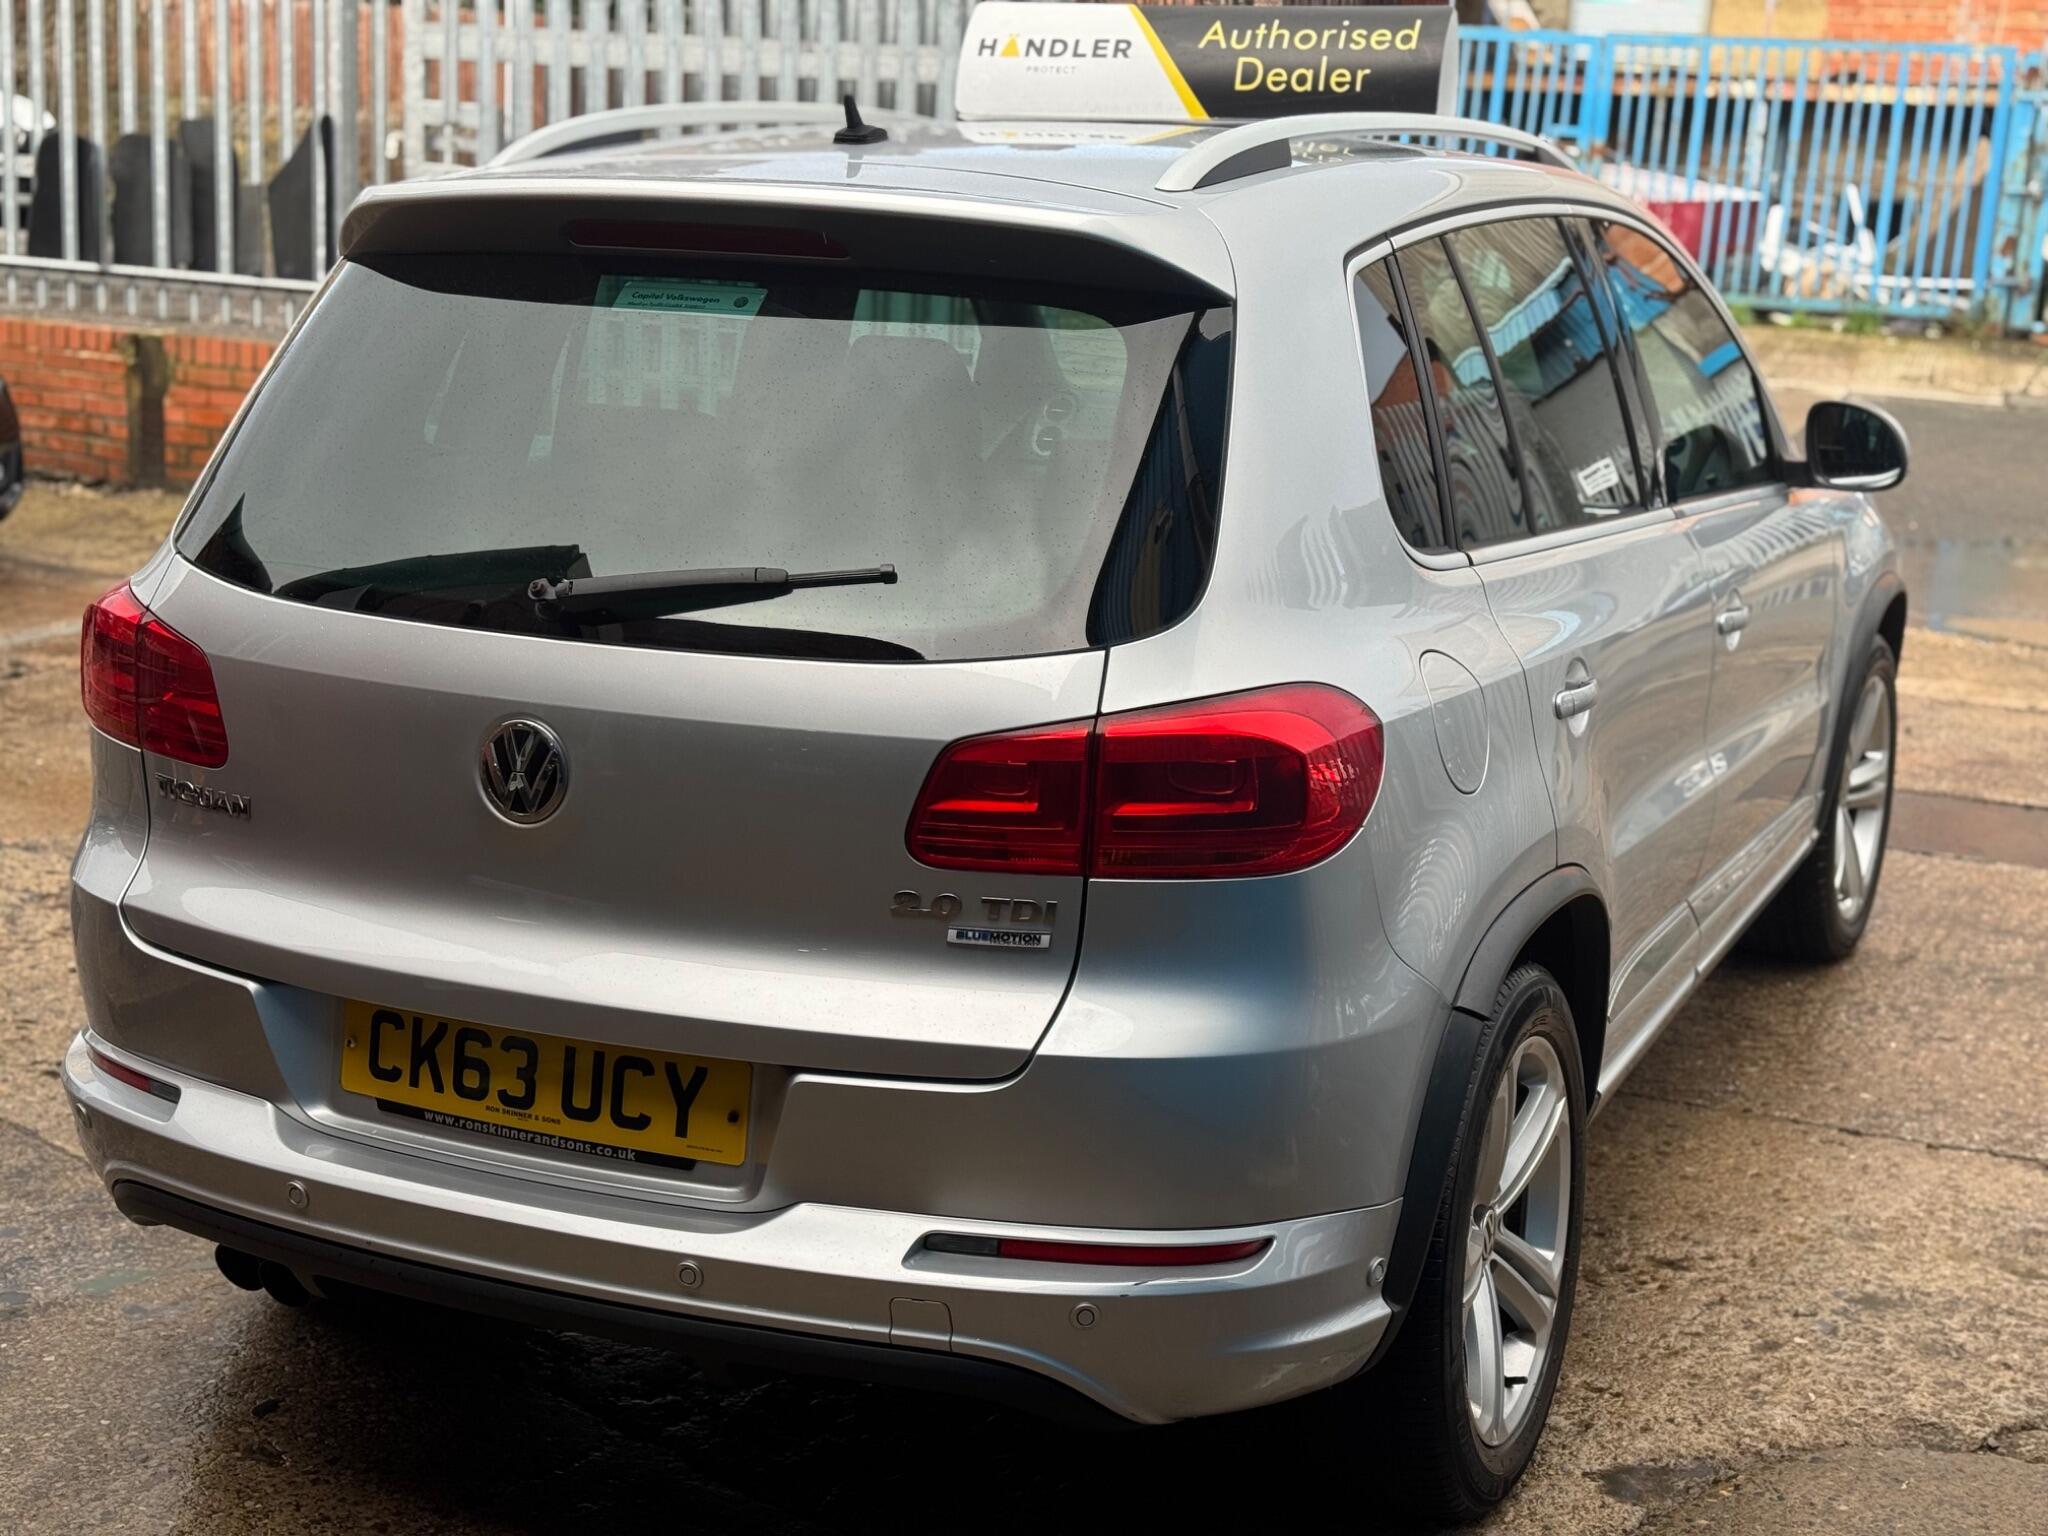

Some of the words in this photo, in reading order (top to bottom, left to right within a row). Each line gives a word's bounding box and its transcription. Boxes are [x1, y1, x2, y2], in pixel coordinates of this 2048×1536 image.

[1198, 19, 1422, 51] Authorised
[1026, 65, 1077, 75] PROTECT
[1234, 56, 1371, 93] Dealer
[666, 293, 720, 304] Volkswagen
[890, 889, 963, 921] 2.0
[980, 896, 1059, 924] TDI
[956, 930, 1042, 944] BLUEMOTION
[368, 1008, 539, 1111] CK63
[560, 1045, 709, 1139] UCY
[485, 1105, 500, 1113] RON
[502, 1108, 533, 1120] SKINNER
[542, 1116, 561, 1125] SONS
[424, 1110, 637, 1161] www.ronskinnerandsons.co.uk
